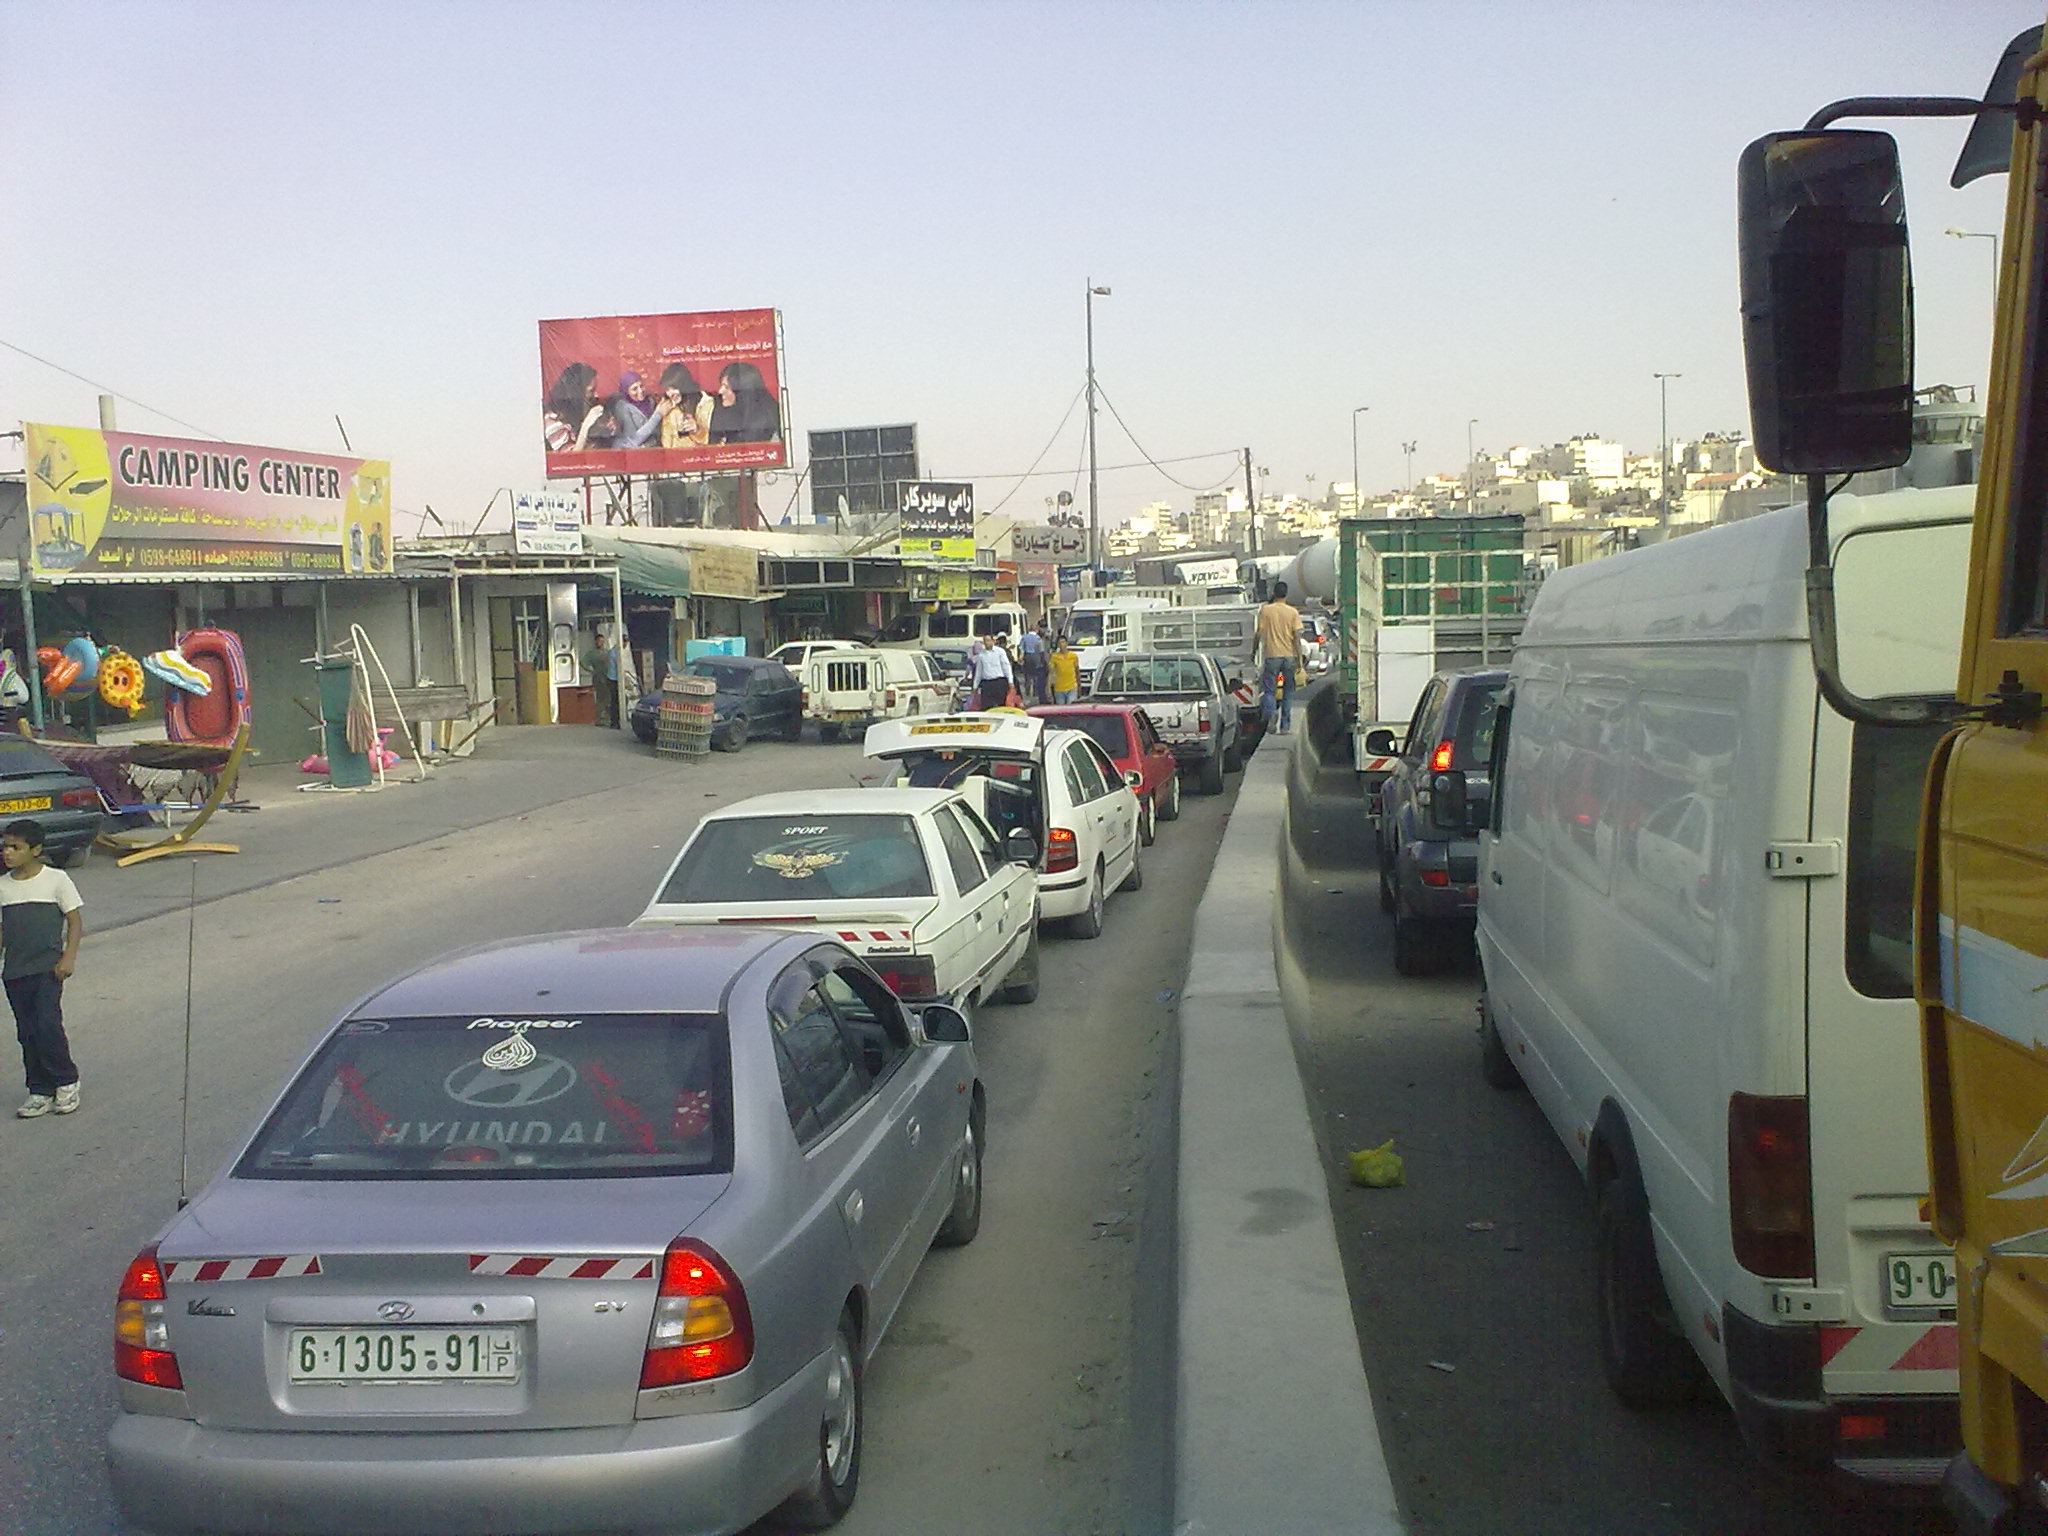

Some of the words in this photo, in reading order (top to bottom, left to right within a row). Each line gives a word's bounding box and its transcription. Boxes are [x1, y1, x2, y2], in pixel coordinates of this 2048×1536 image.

[118, 445, 249, 493] CAMPING
[258, 459, 341, 499] CENTER
[948, 488, 971, 517] رامي
[1013, 534, 1049, 554] سيارات
[1052, 534, 1085, 554] زجاج
[781, 826, 829, 836] SPORT
[467, 1017, 582, 1030] Pioneer
[378, 1121, 607, 1145] HYUNDAI
